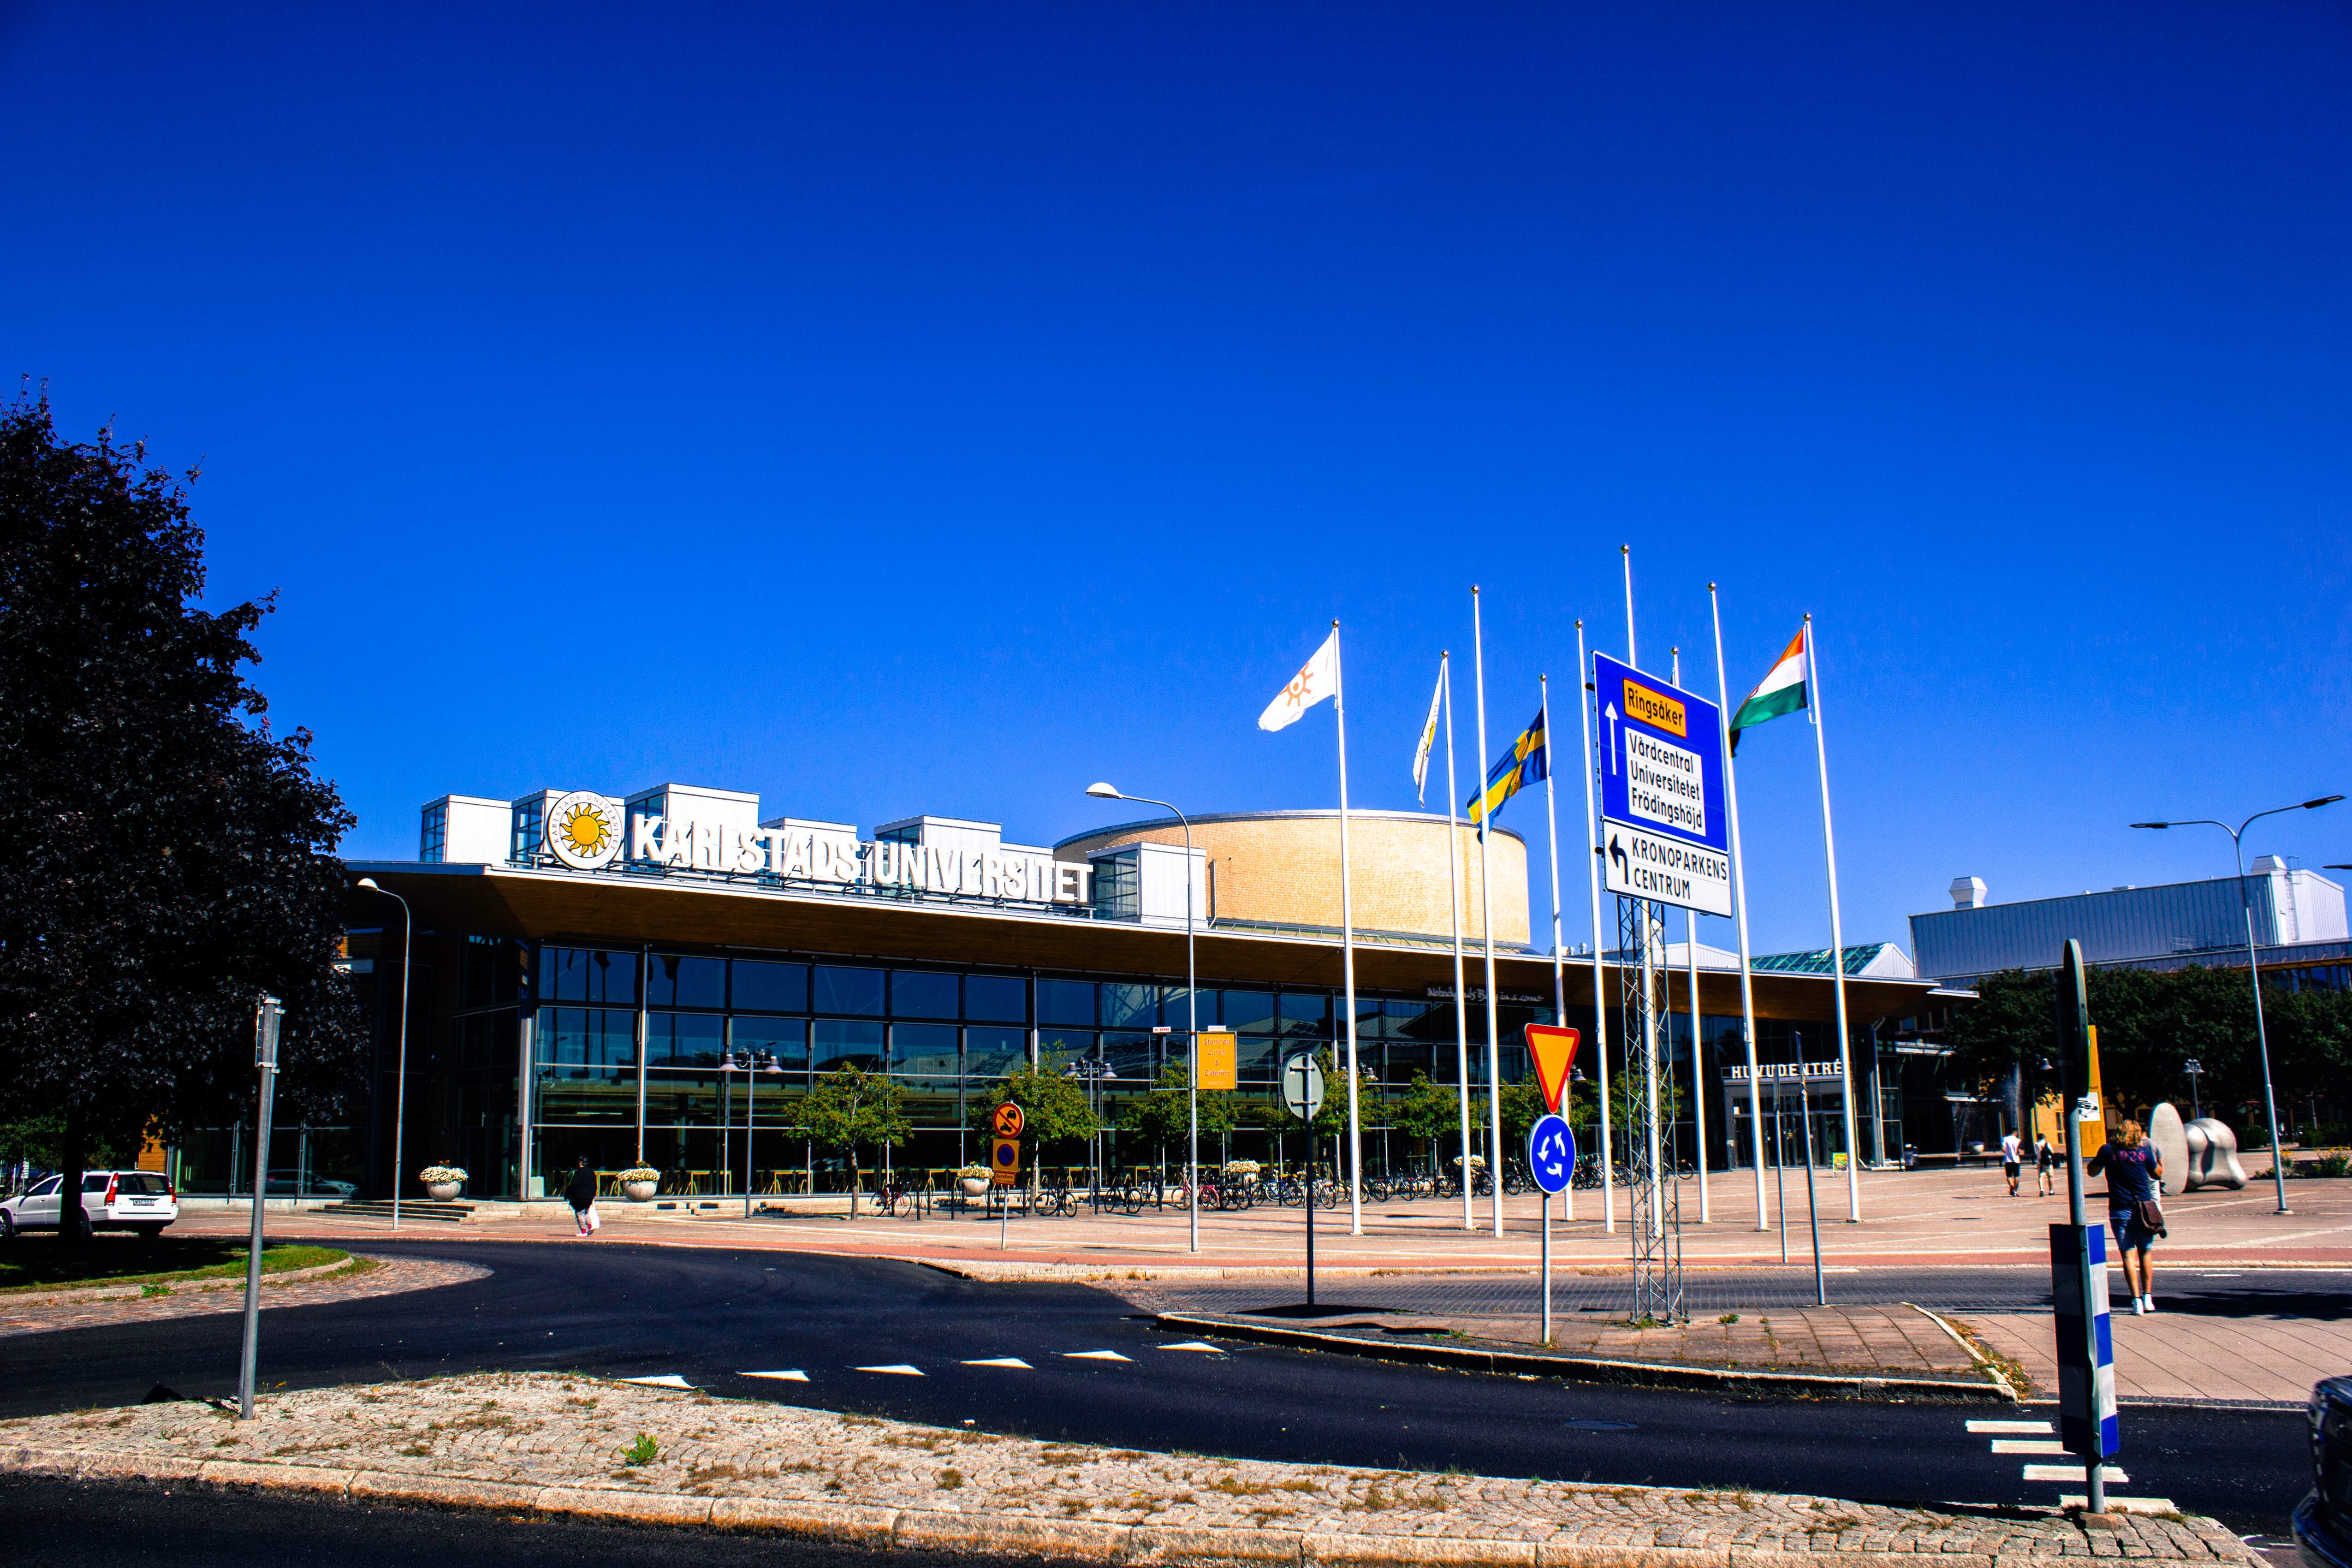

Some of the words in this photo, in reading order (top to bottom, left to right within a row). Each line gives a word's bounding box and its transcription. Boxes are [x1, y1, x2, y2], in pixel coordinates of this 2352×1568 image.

[1628, 687, 1683, 727] Ringsåker
[1629, 732, 1693, 774] Vårdcentral
[1631, 760, 1700, 801] Universitetet
[552, 795, 581, 843] KARLSTADS
[587, 795, 619, 851] UNIVERSITET
[1632, 787, 1702, 831] Frödingshöjd
[632, 813, 861, 880] KARLSTADS
[873, 841, 1093, 903] UNIVERSITET
[1632, 837, 1727, 880] KRONOPARKENS
[1634, 867, 1691, 900] CENTRUM
[1204, 1069, 1230, 1078] Catering
